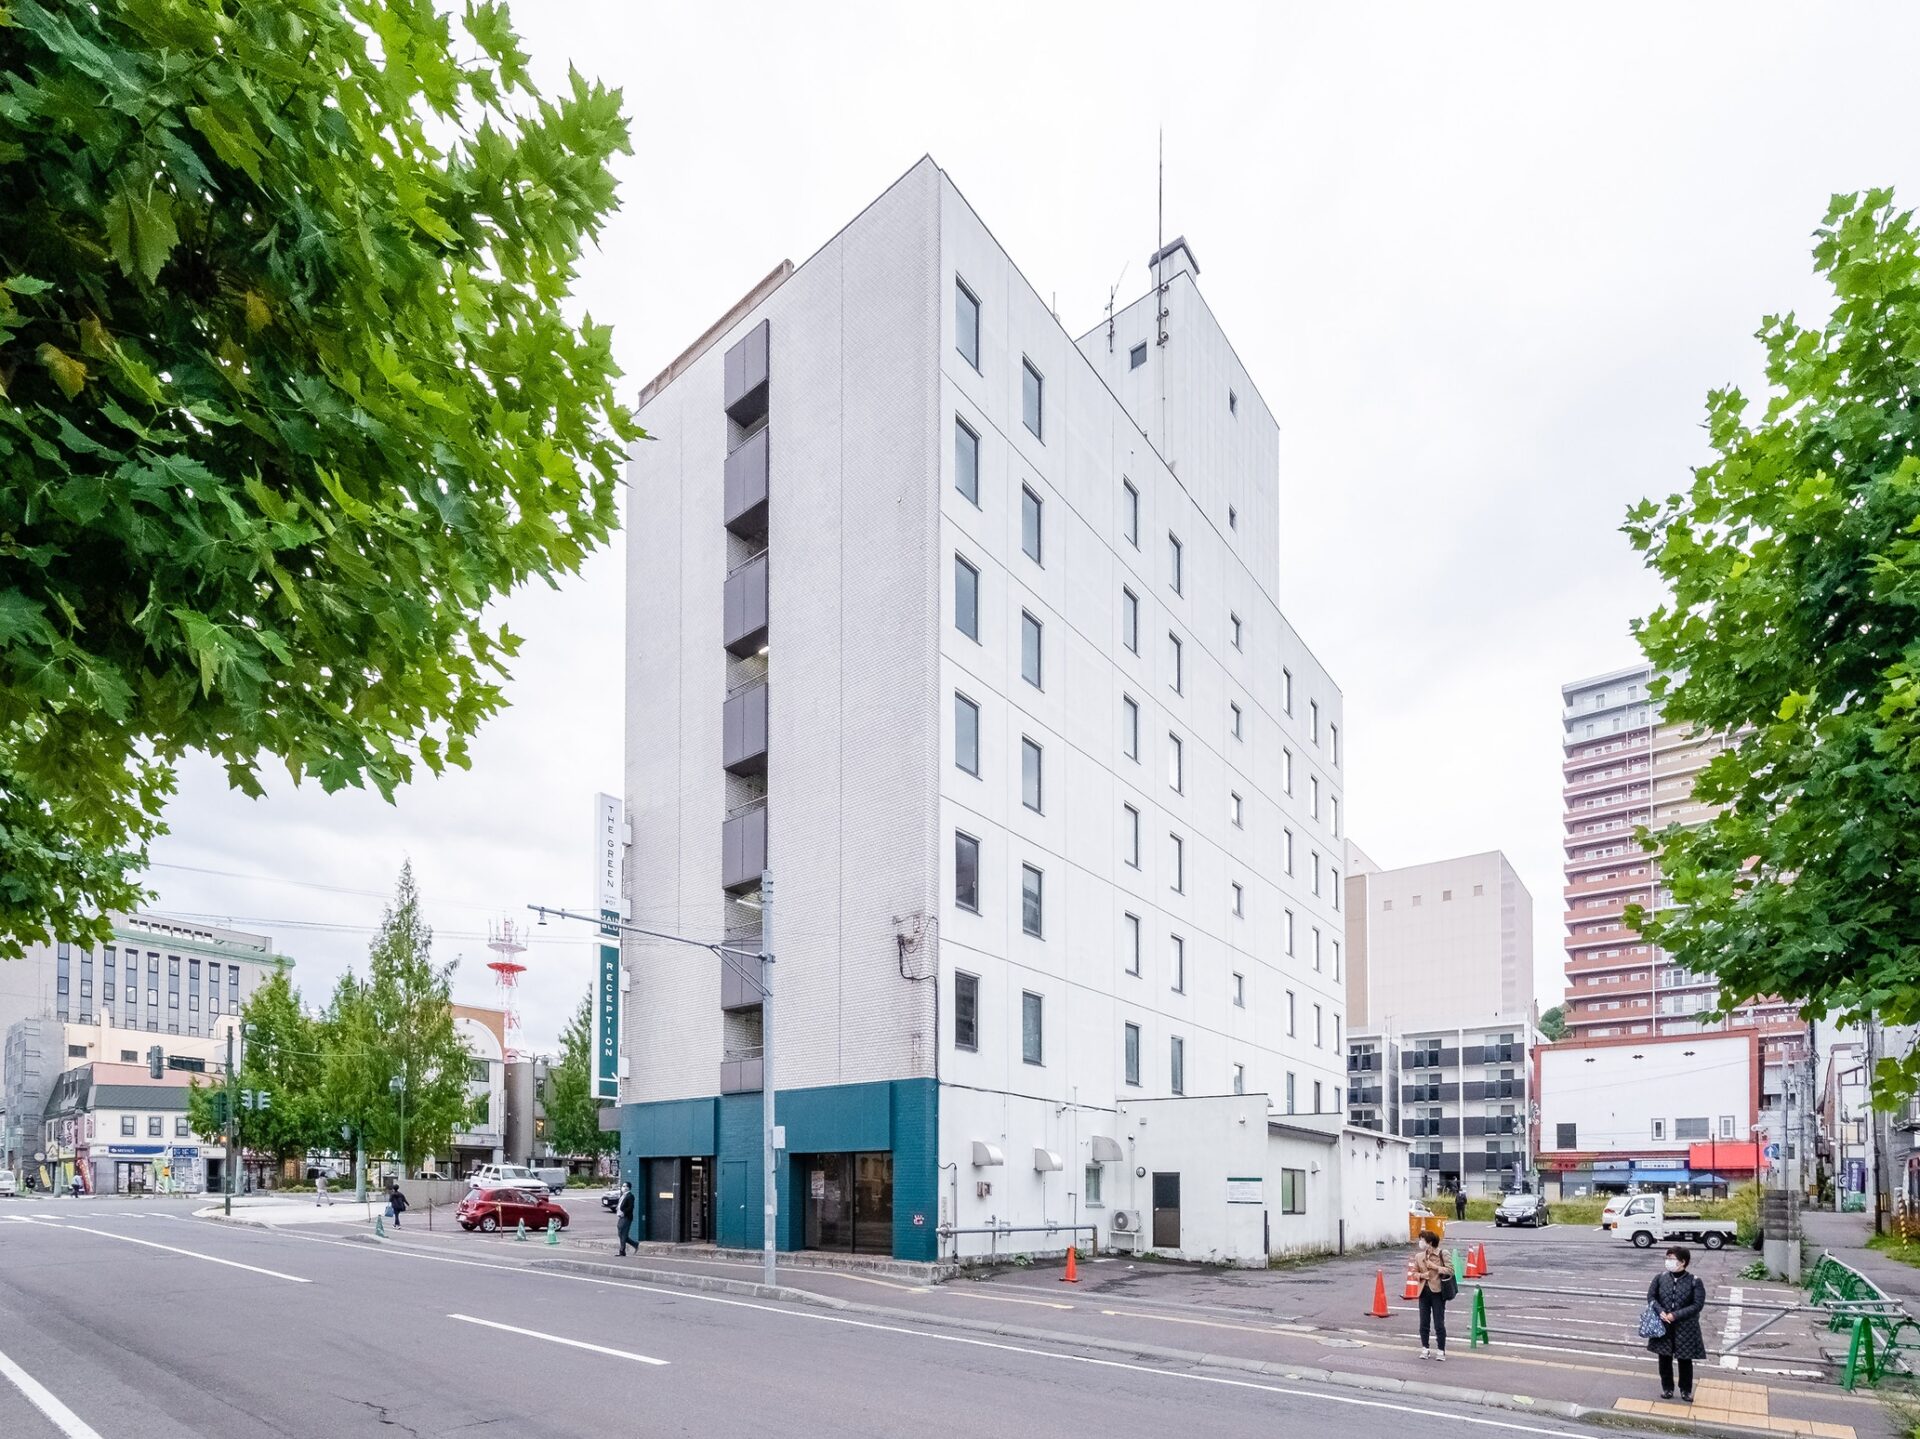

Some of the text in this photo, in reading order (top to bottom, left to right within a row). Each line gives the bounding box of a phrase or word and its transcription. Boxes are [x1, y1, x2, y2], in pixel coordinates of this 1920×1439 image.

[607, 805, 615, 834] THE
[607, 839, 615, 888] GREEN
[605, 962, 613, 1056] RECEPTION
